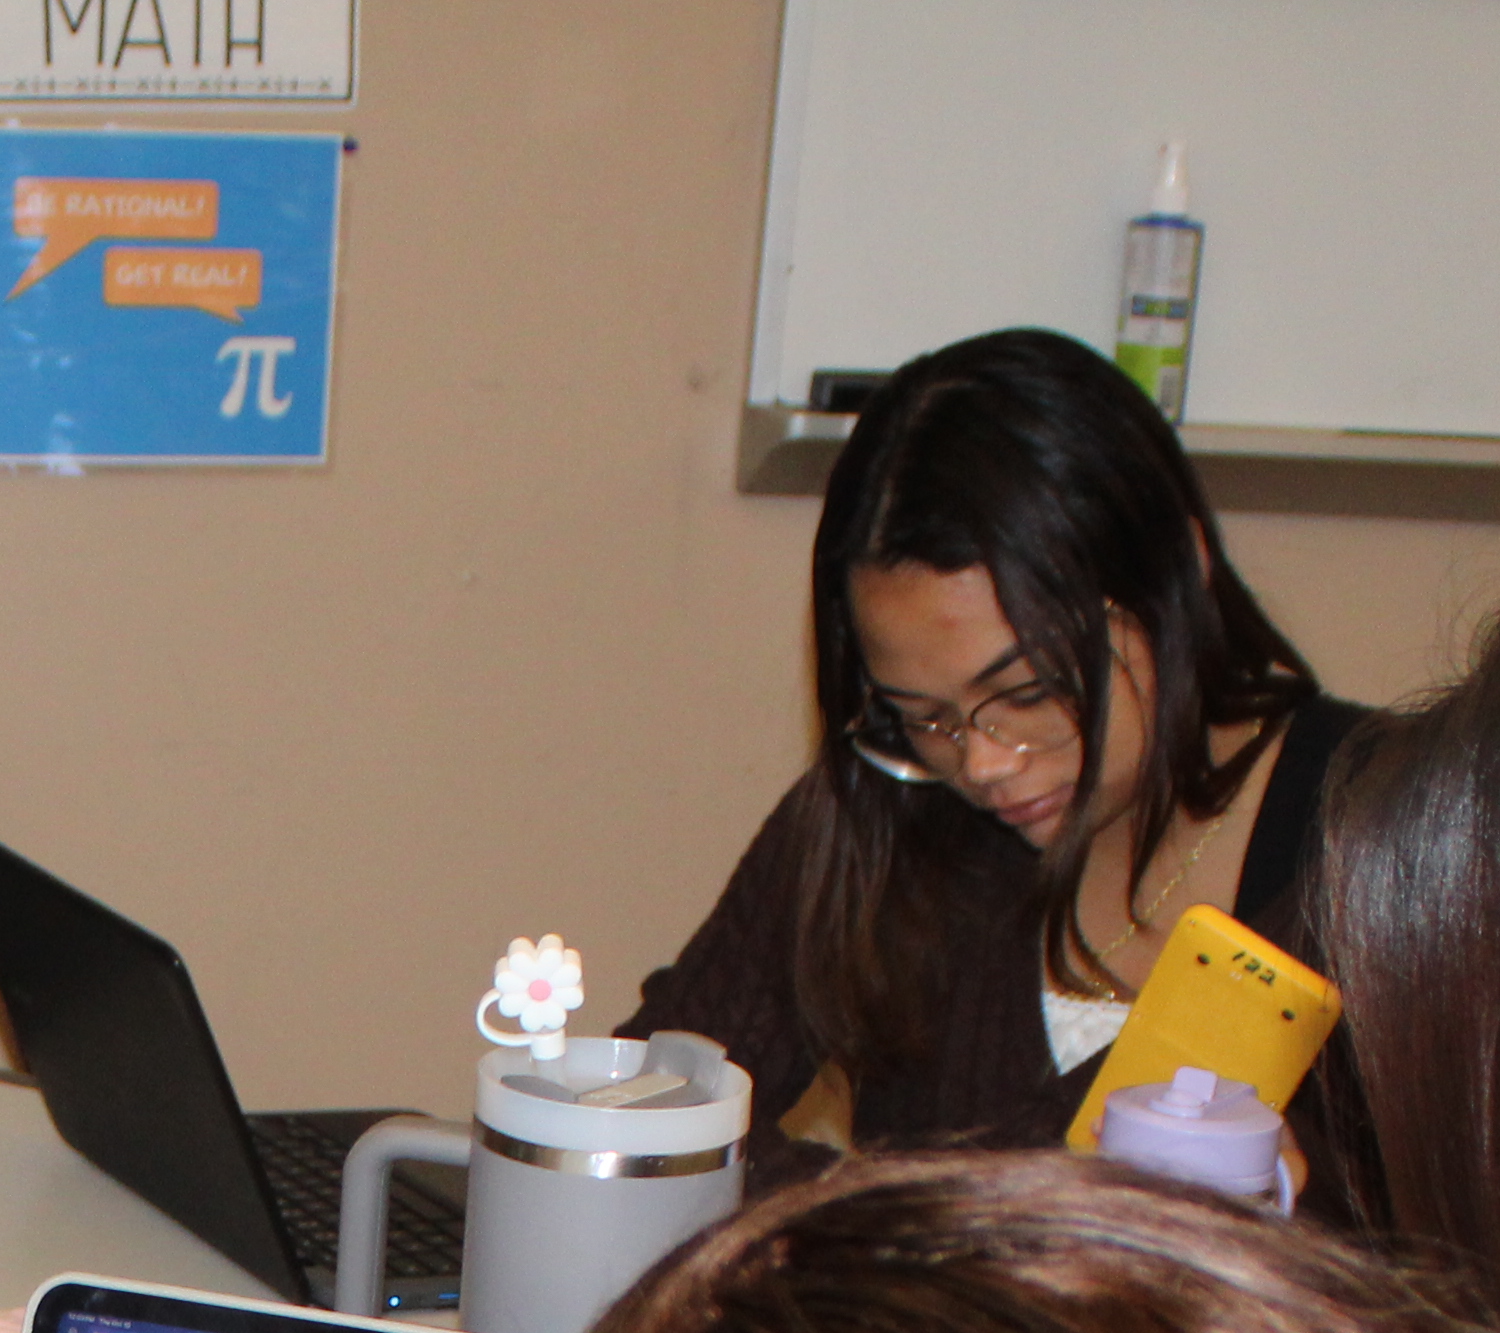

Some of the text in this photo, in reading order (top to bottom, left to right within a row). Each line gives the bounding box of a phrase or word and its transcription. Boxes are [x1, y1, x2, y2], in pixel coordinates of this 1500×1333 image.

[64, 193, 206, 219] RATIONAL!
[115, 262, 249, 288] GET REAL!
